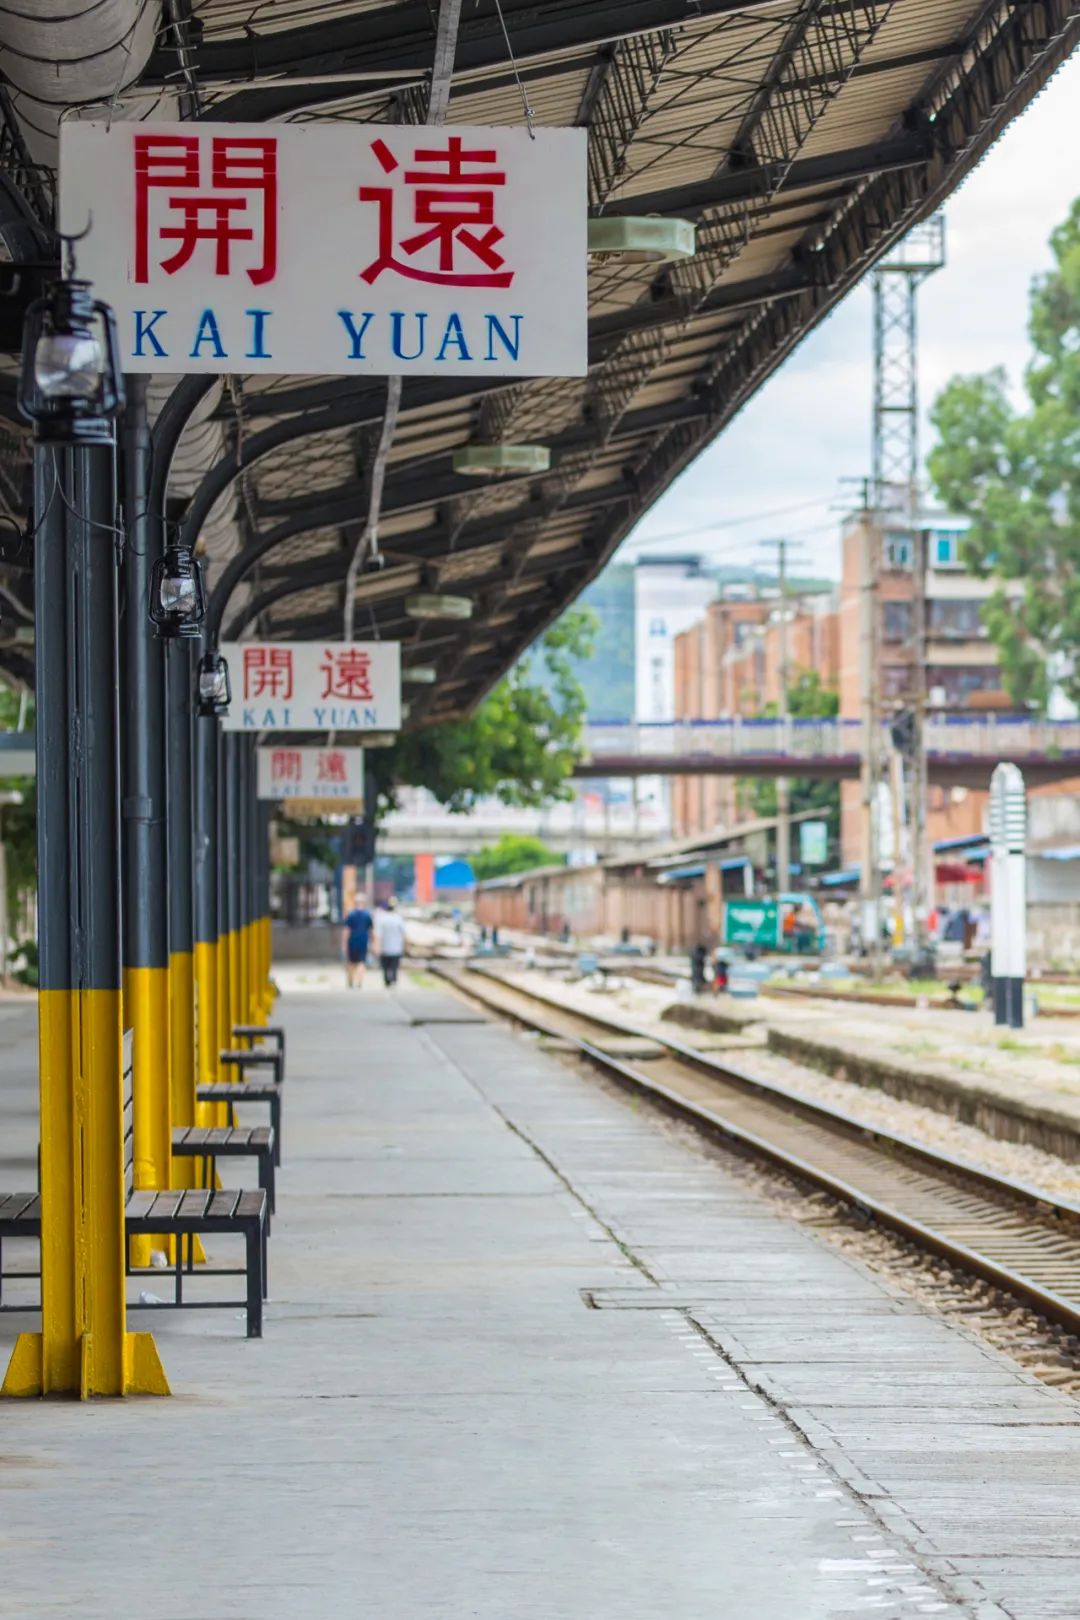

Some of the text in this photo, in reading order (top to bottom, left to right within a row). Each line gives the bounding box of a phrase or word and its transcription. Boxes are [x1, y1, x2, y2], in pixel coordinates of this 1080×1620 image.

[133, 135, 515, 288] 開遠
[131, 309, 525, 362] KAI YUAN
[243, 648, 374, 701] 開遠
[243, 708, 377, 727] KAI YUAN
